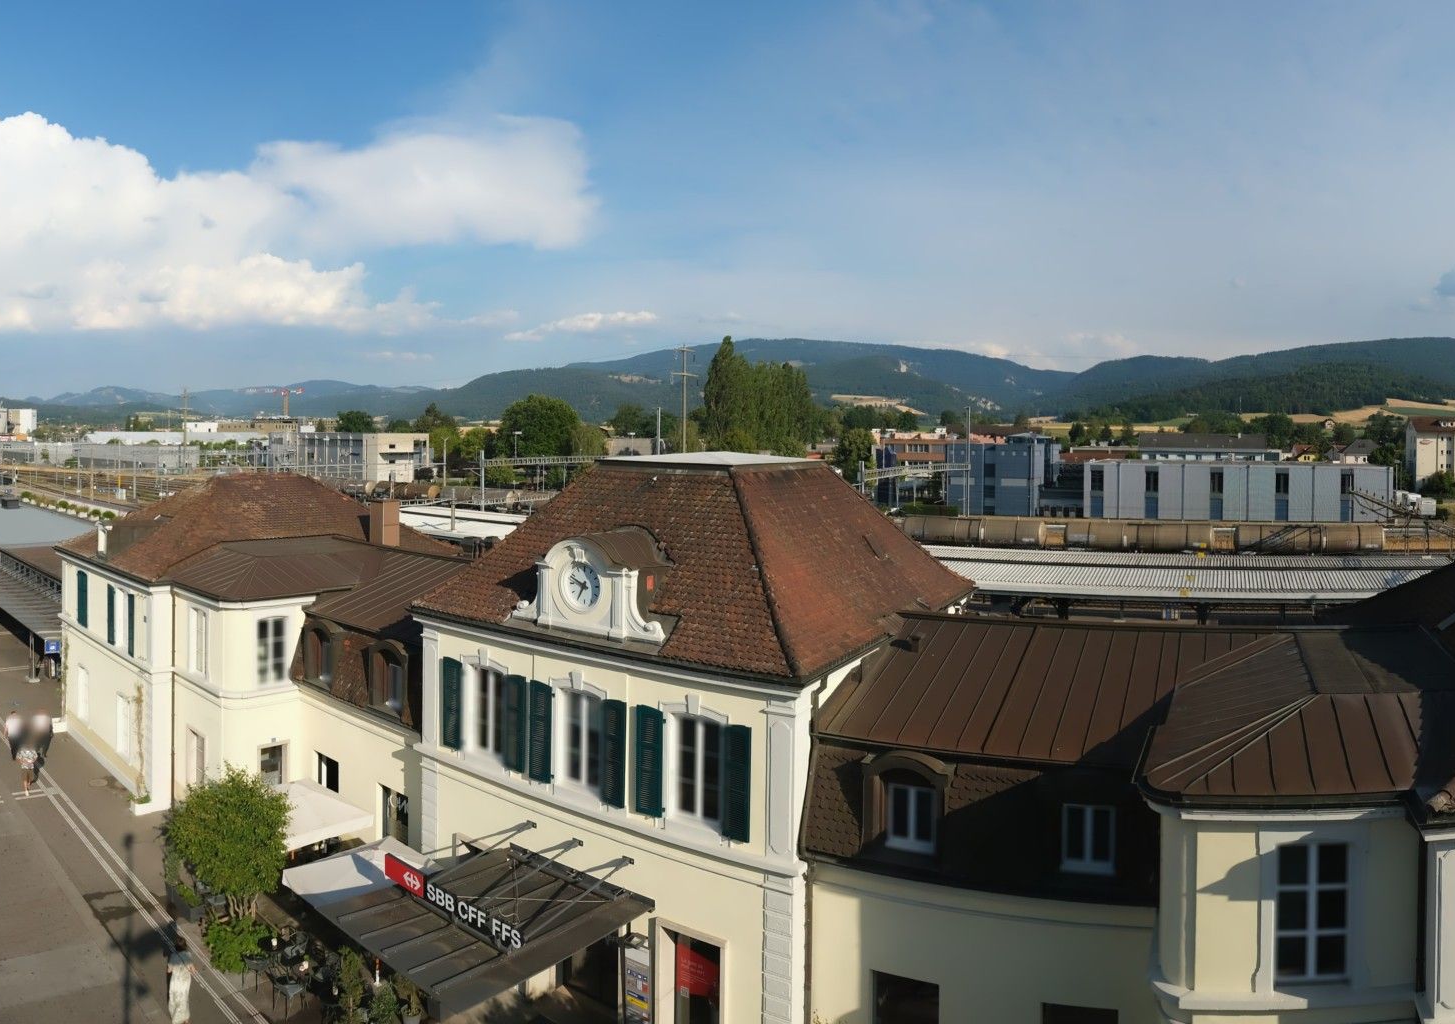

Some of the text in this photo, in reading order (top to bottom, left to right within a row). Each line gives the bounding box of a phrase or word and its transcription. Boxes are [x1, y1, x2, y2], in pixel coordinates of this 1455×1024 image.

[426, 884, 522, 950] SBB CFF FFS
